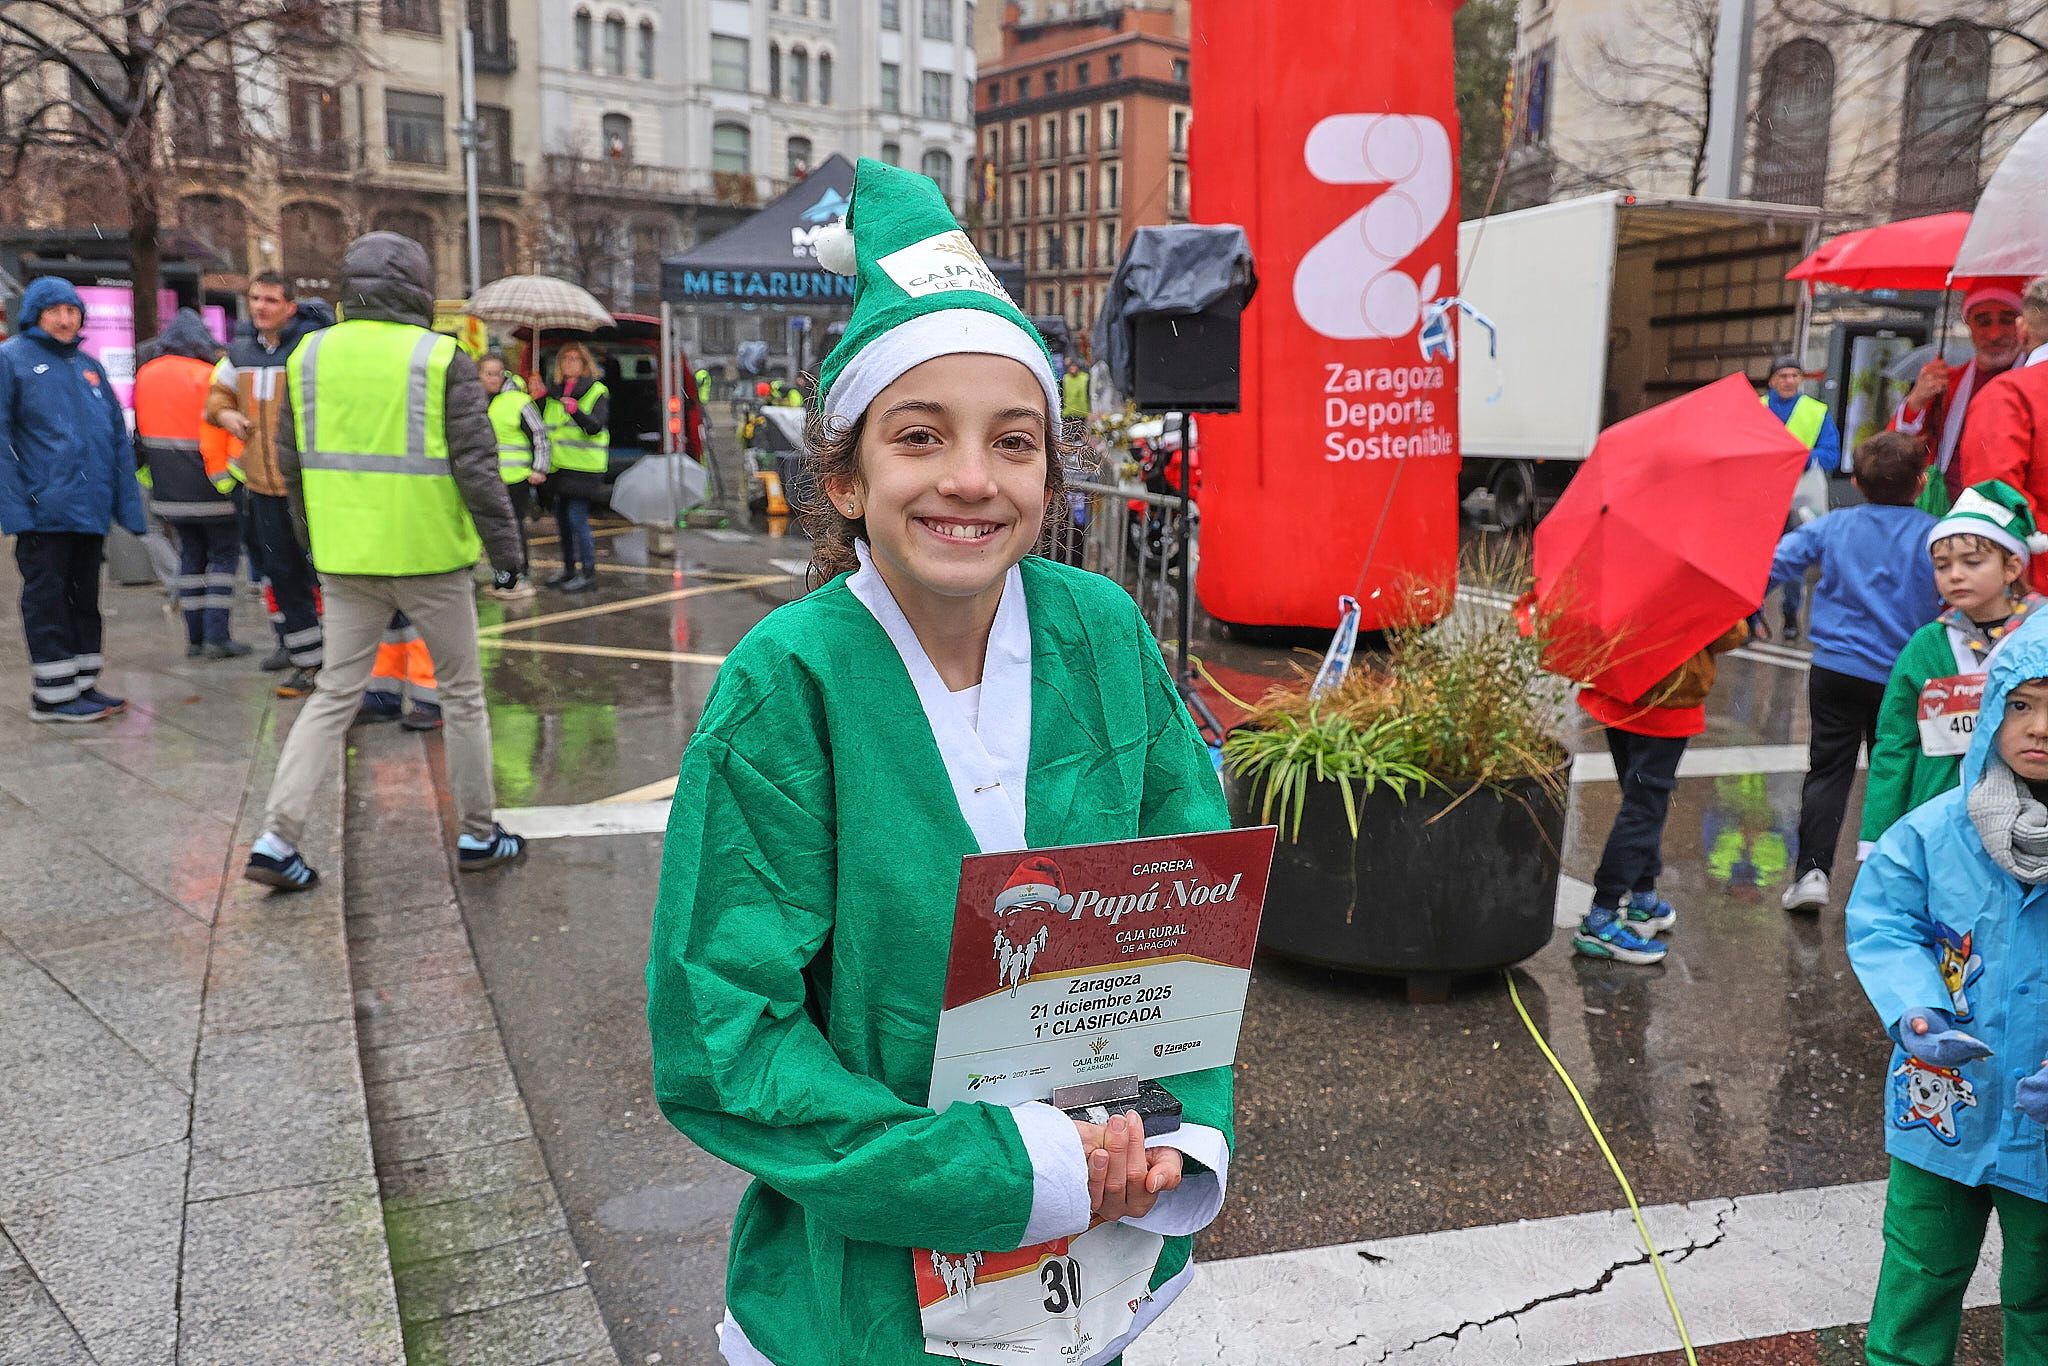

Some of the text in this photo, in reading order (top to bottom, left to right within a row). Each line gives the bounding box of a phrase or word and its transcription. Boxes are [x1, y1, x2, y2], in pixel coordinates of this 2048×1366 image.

[909, 265, 974, 287] CAJA
[934, 280, 963, 290] DE
[1324, 362, 1444, 398] Zaragoza
[1325, 397, 1435, 433] Deporte
[1324, 425, 1453, 462] Sostenible
[1950, 715, 1980, 734] 40
[1132, 858, 1194, 876] CARRERA
[1069, 872, 1243, 926] Papá Noel
[1115, 924, 1187, 944] CAJA RURAL
[1121, 938, 1178, 954] DE ARAGÓN
[1068, 973, 1141, 994] Zaragoza
[1030, 985, 1172, 1019] 21 diciembre 2025
[1034, 1005, 1162, 1038] 1ª CLASIFICADA
[1165, 1040, 1202, 1052] Zaragoza
[1072, 1053, 1120, 1067] CAJA RURAL
[1087, 1062, 1114, 1072] ARAGÓN
[1012, 1070, 1028, 1079] 2027
[1041, 1256, 1081, 1313] 30
[993, 1342, 1010, 1351] 2027
[1066, 1356, 1076, 1364] DE
